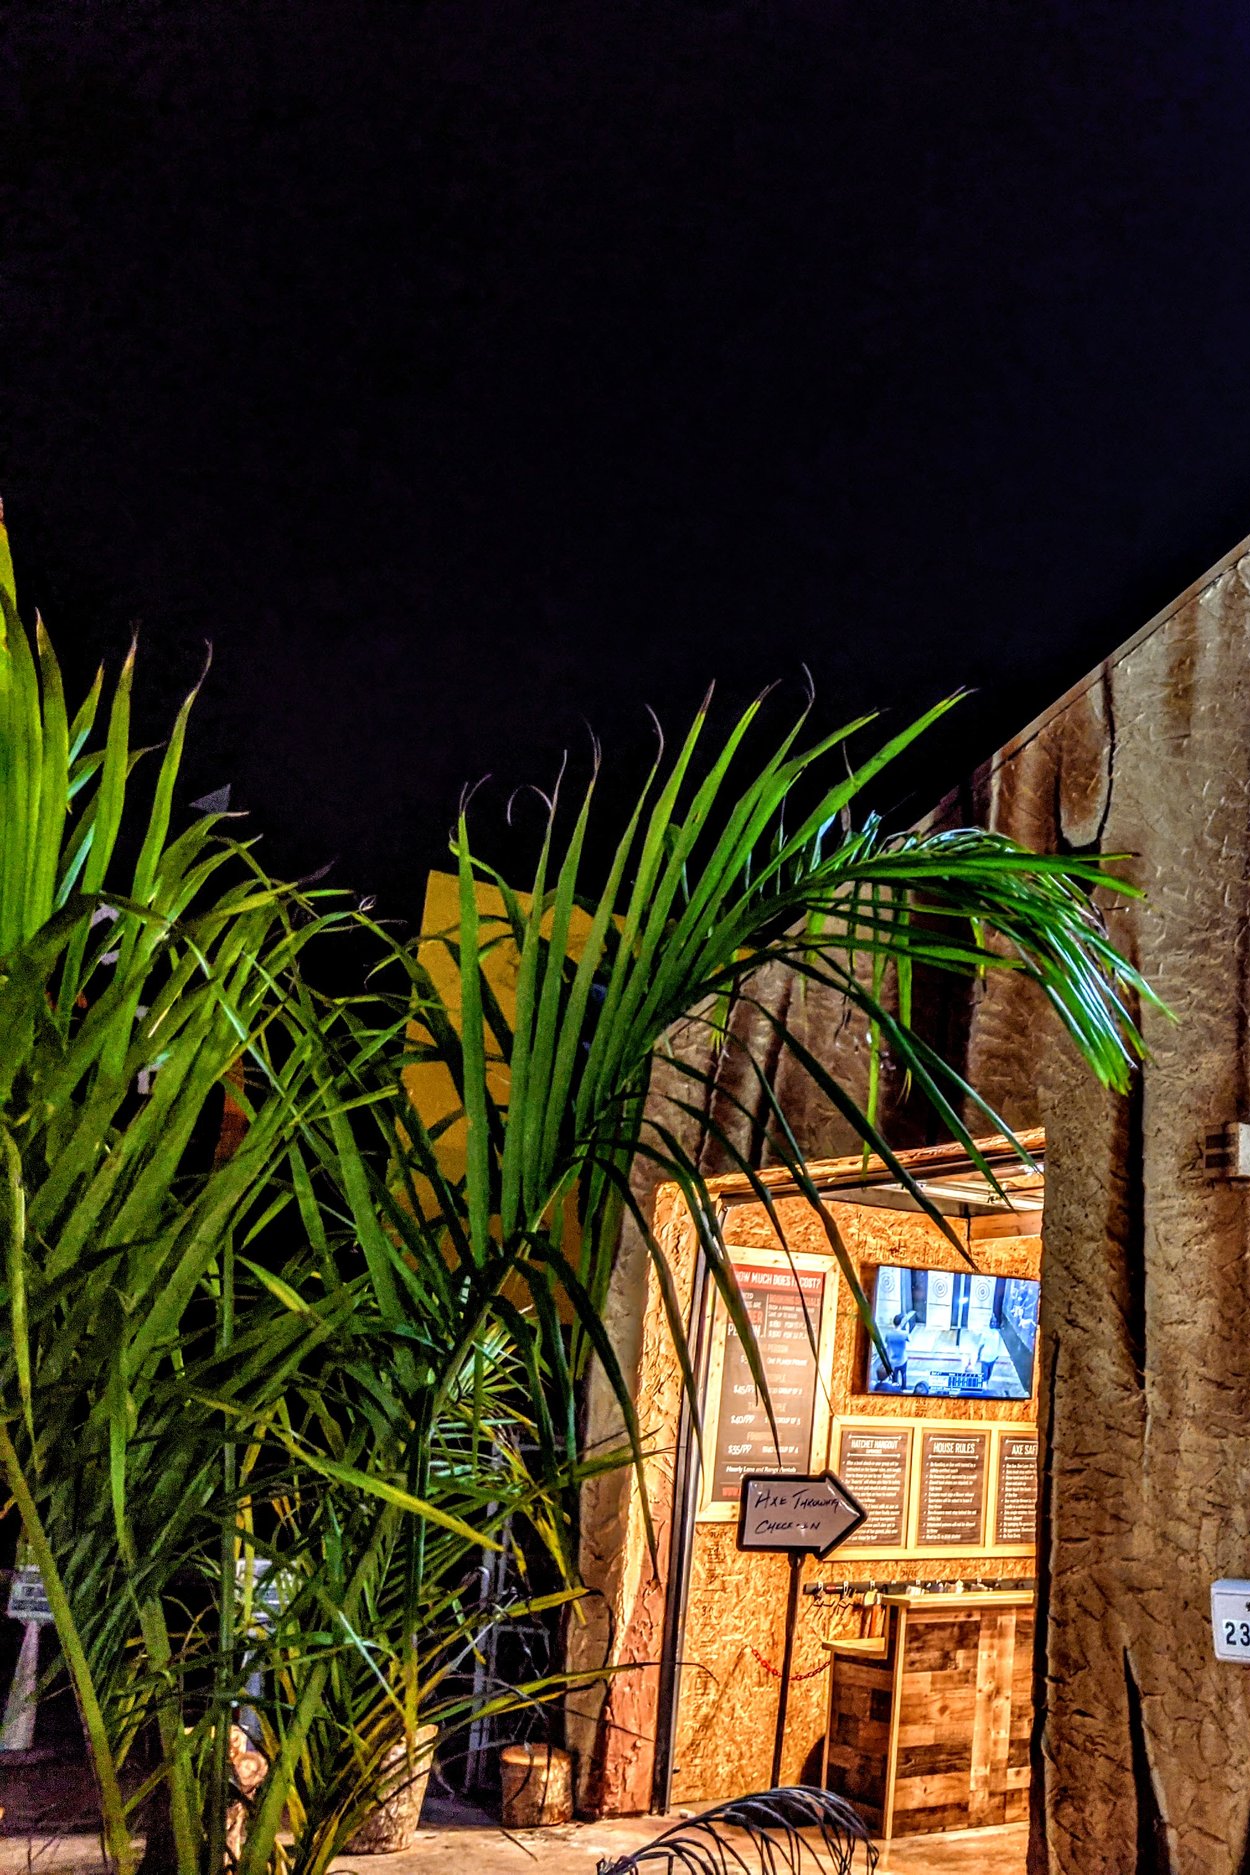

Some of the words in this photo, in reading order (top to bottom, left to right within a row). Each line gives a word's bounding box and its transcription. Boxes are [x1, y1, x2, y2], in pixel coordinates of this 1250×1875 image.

[751, 1271, 772, 1286] MUCH
[772, 1274, 791, 1288] DOES
[800, 1277, 822, 1290] COST?
[728, 1443, 752, 1456] $35/PP
[933, 1442, 954, 1453] HOUSE
[955, 1442, 976, 1454] RULES
[1011, 1444, 1024, 1455] AXE
